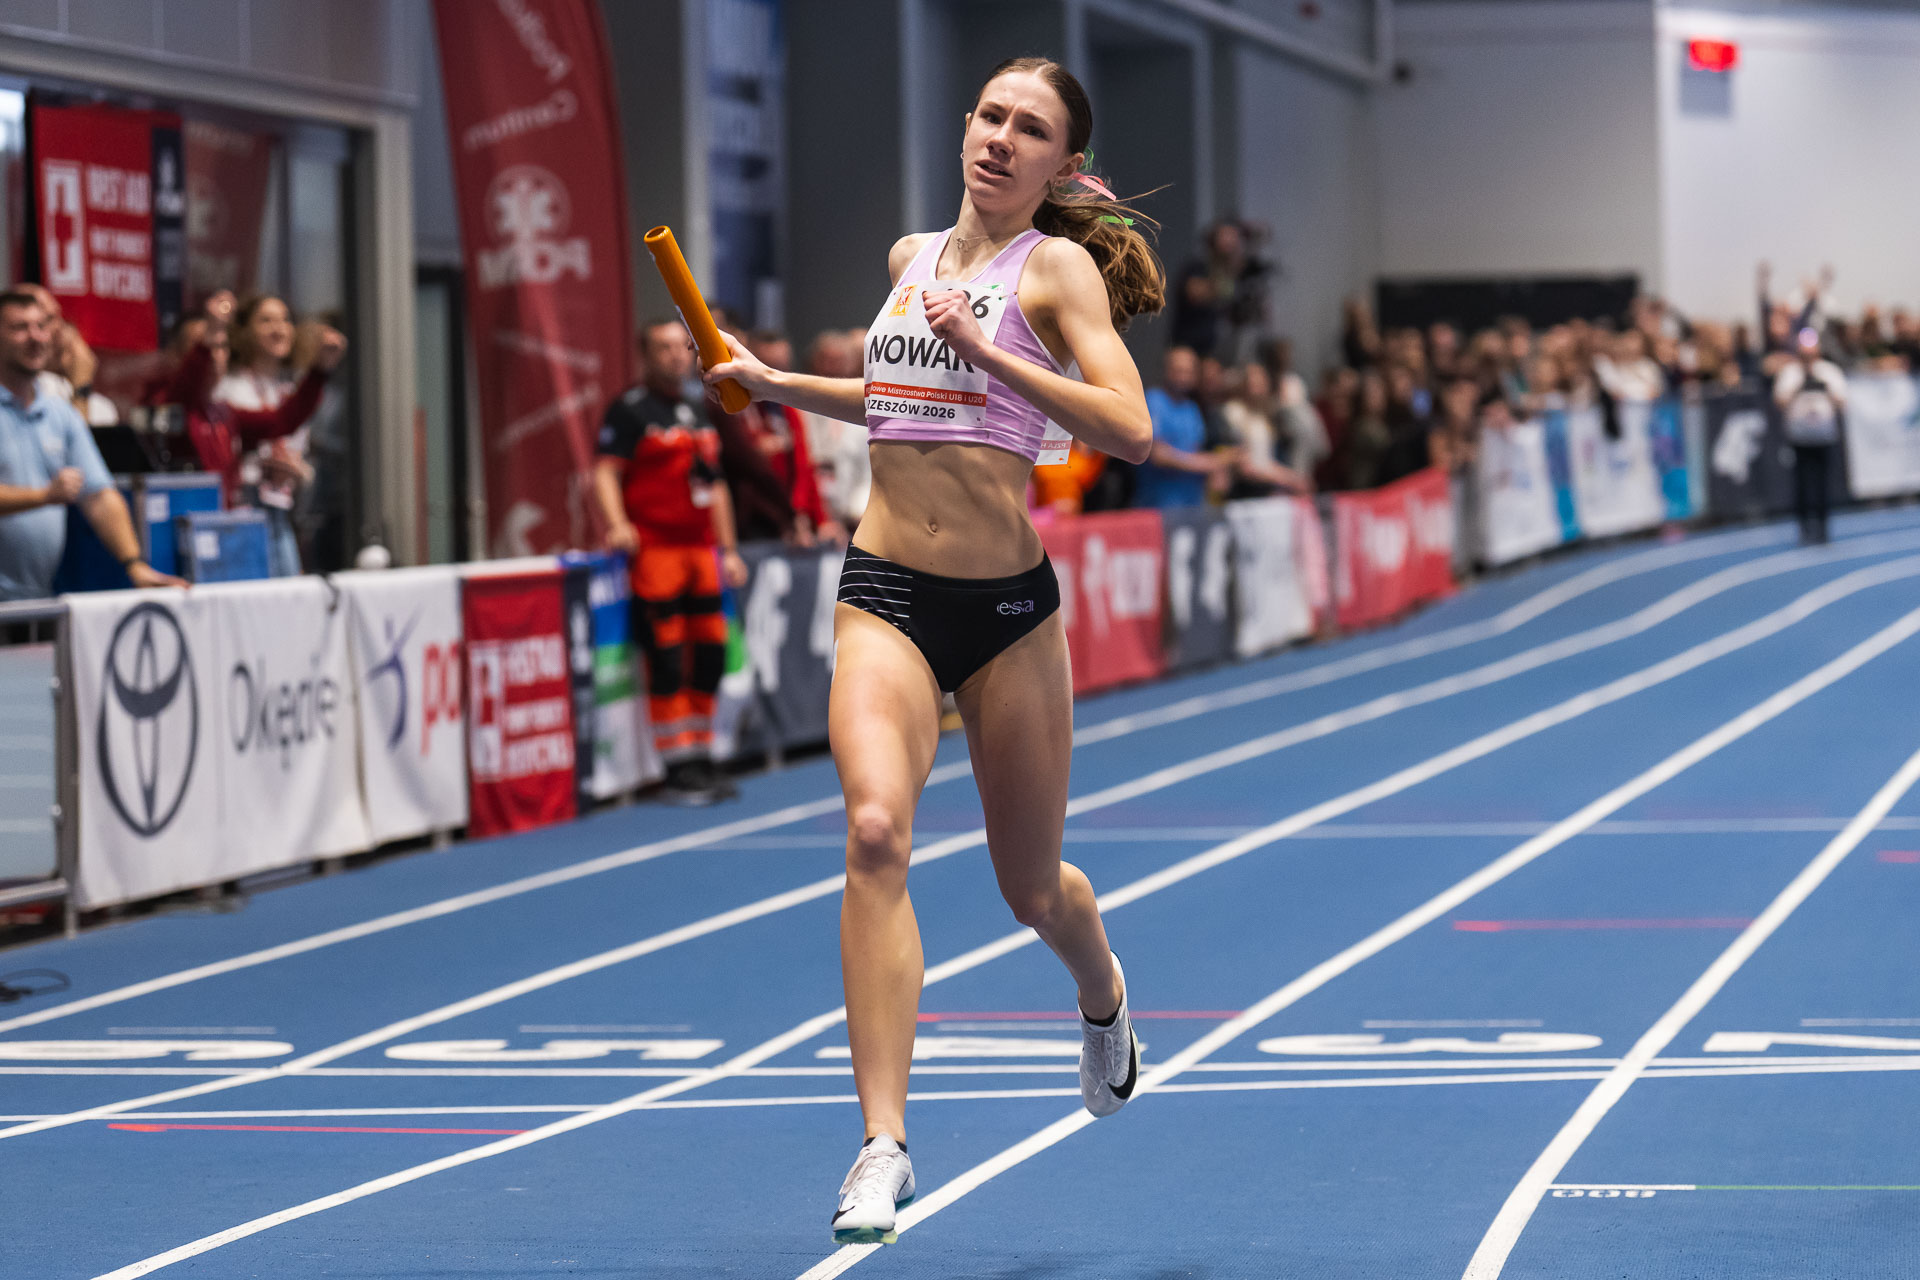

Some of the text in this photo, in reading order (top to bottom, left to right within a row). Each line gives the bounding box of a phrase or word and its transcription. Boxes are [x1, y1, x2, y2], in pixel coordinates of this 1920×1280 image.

[888, 386, 926, 398] Mistrzostwa
[926, 391, 947, 401] Polski
[968, 395, 984, 404] U20
[868, 399, 956, 419] ZESZÓW 2026
[385, 1039, 725, 1062] 5
[1256, 1032, 1604, 1056] 3
